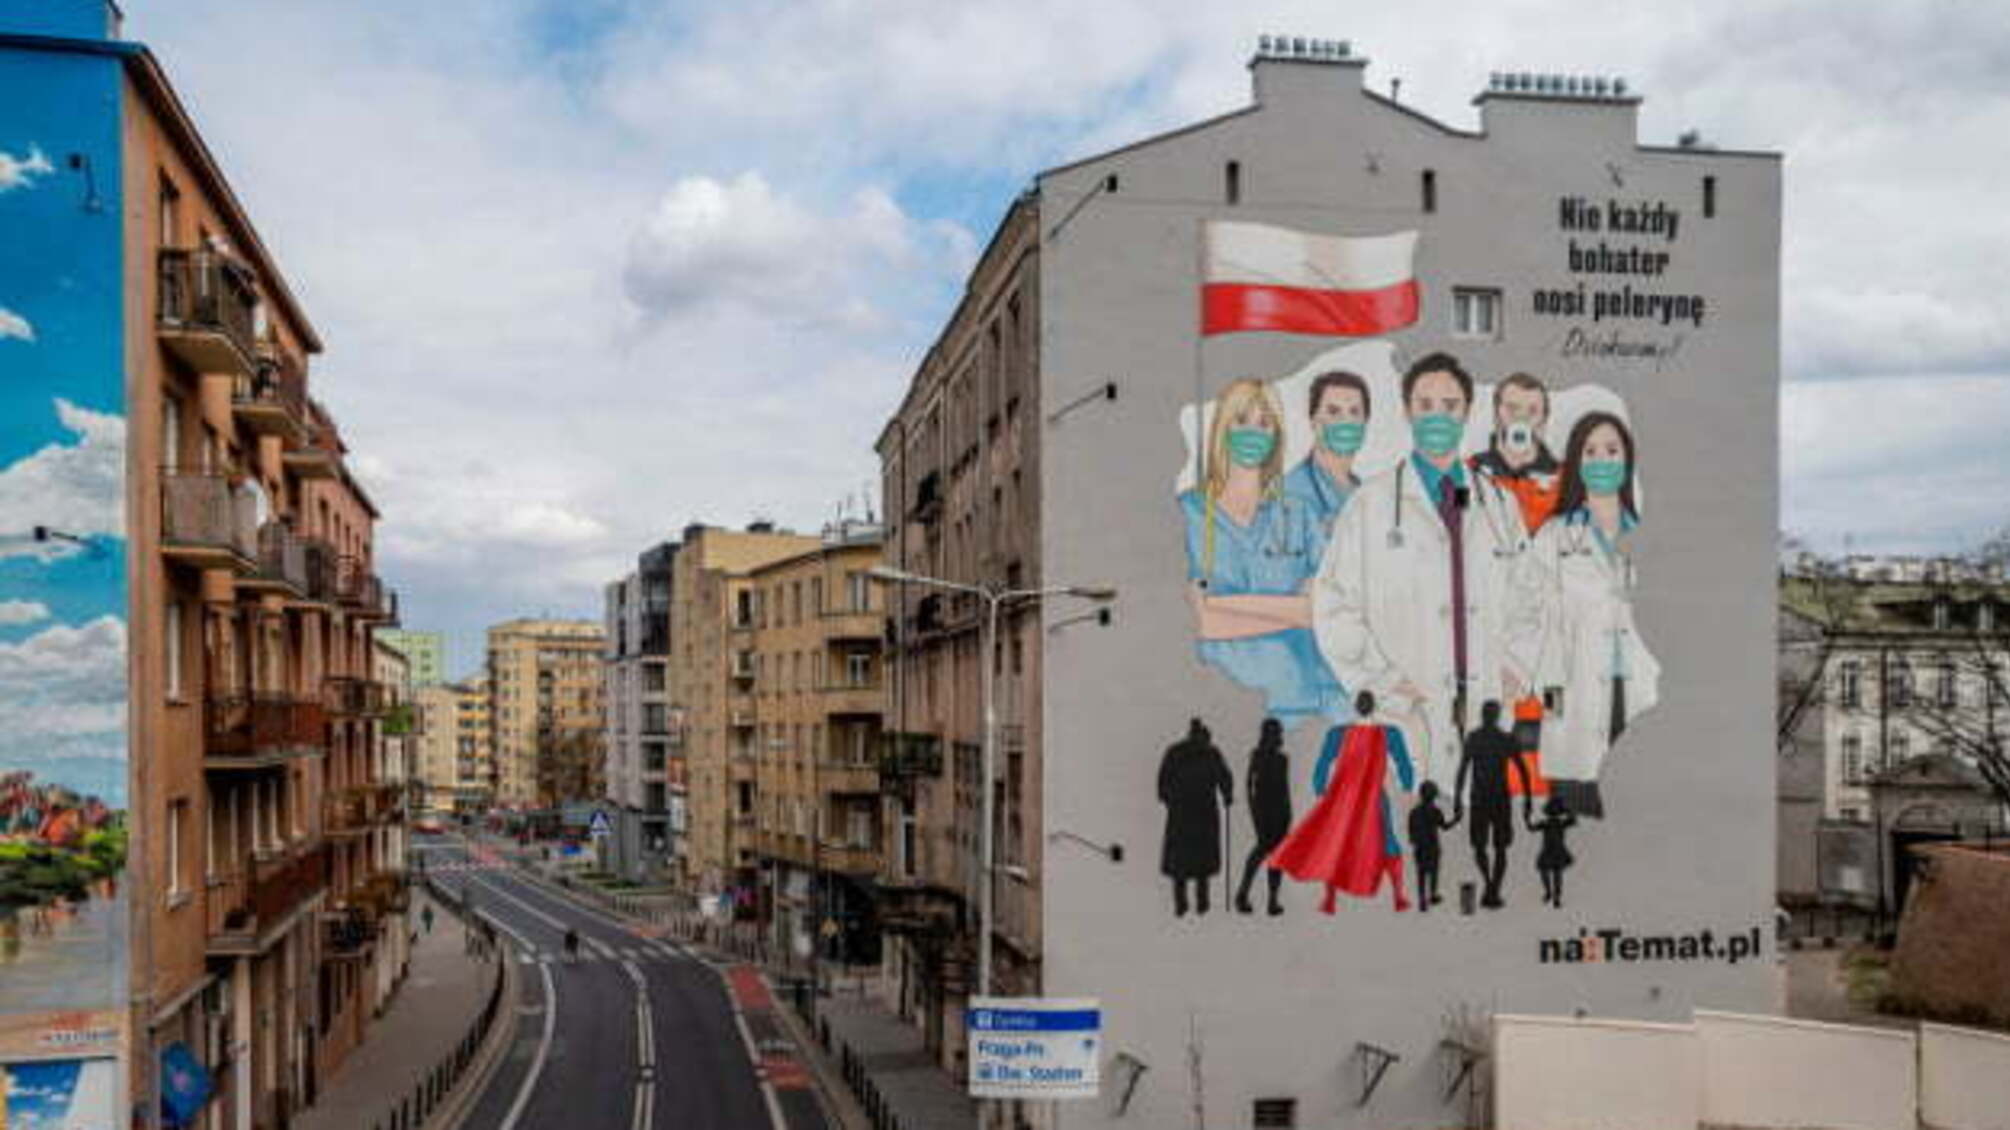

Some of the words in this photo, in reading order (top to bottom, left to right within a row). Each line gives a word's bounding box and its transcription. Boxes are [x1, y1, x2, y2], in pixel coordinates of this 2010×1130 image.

[1559, 197, 1600, 231] Nie
[1607, 199, 1679, 241] każdy
[1568, 238, 1670, 274] bohater
[1533, 282, 1585, 315] nosi
[1593, 284, 1705, 327] pelerynę
